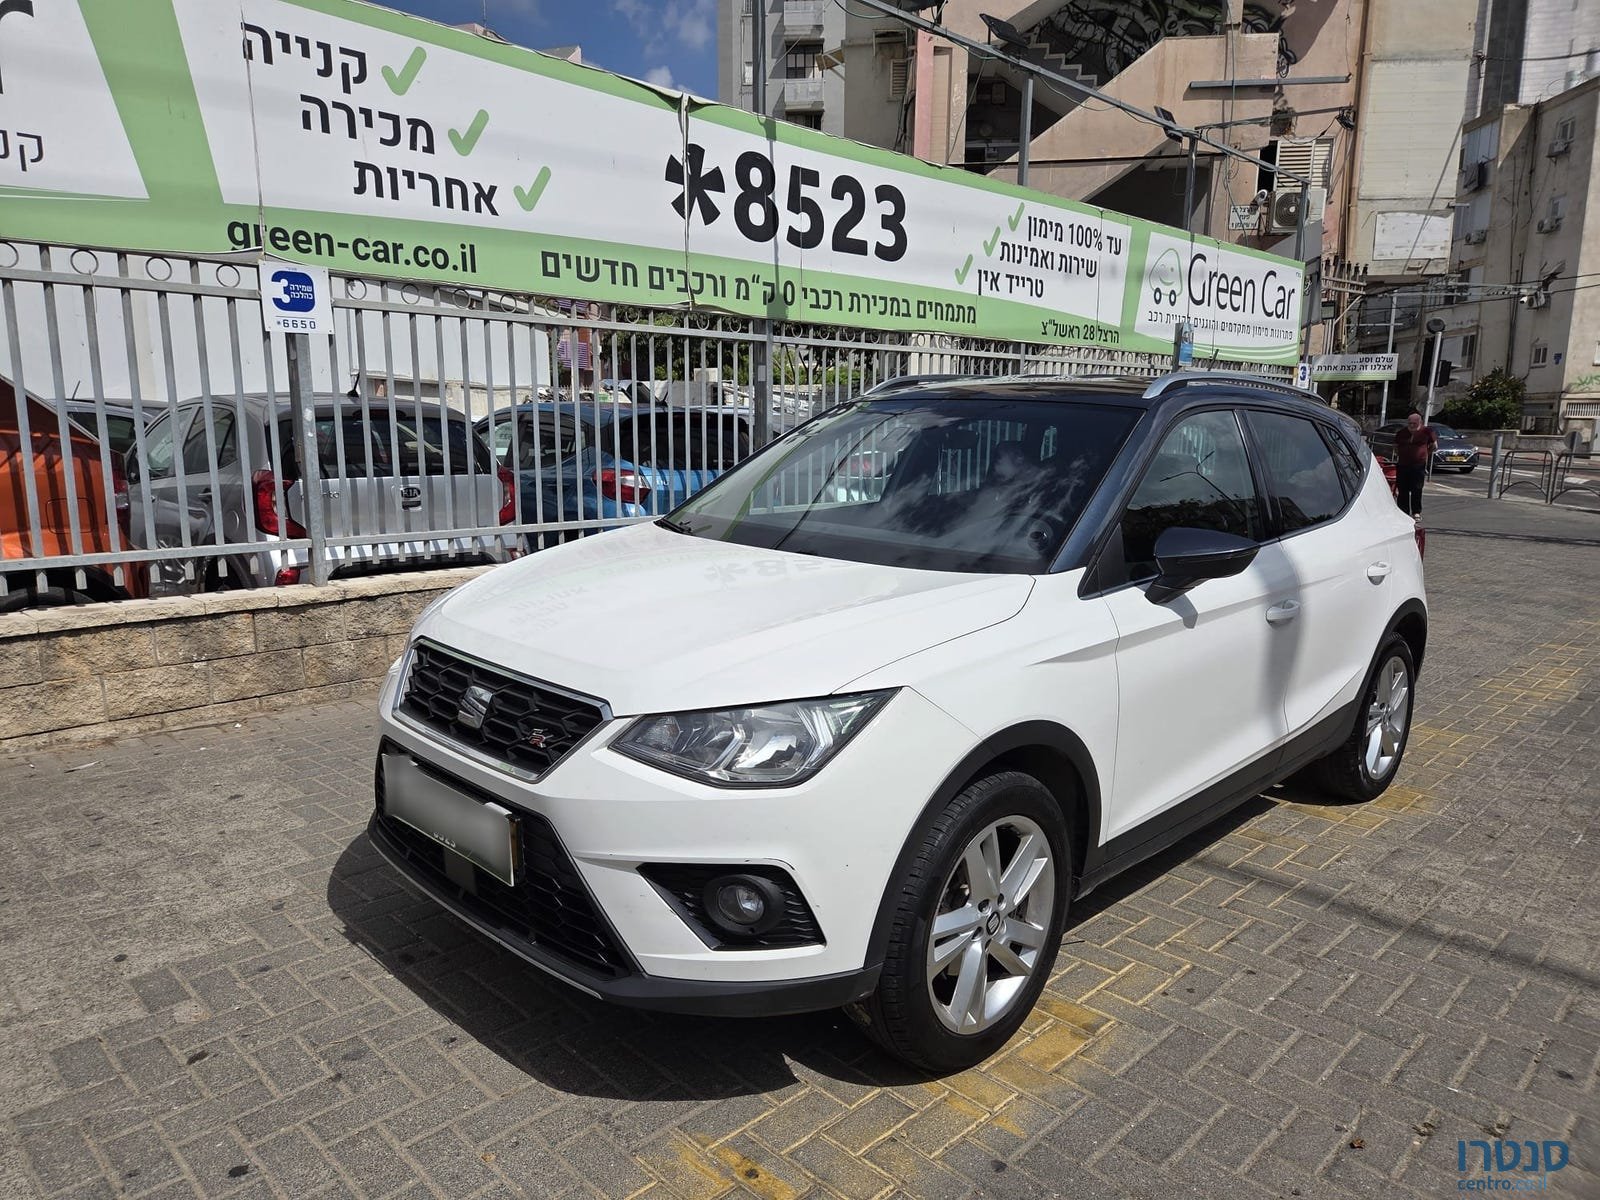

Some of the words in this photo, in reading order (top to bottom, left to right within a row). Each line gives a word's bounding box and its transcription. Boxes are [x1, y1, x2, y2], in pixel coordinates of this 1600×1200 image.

[240, 22, 368, 95] קנייה
[300, 94, 435, 155] מכירה
[353, 160, 500, 216] אחריות
[1027, 215, 1064, 242] מימון
[1068, 223, 1103, 251] 100%
[227, 220, 477, 274] green-car.co.il
[999, 241, 1055, 270] ואמינות
[1106, 235, 1122, 255] עד
[541, 250, 639, 287] חדשים
[1057, 253, 1097, 278] שירות
[289, 284, 313, 292] שמירה
[648, 265, 727, 298] ורכבים
[783, 280, 796, 306] 0
[977, 269, 1001, 296] אין
[1005, 273, 1044, 298] טרייד
[1187, 253, 1256, 314] Green
[1261, 270, 1296, 320] Car
[801, 286, 843, 311] רכבי
[848, 292, 912, 318] במכירת
[916, 300, 976, 324] מתמחים
[1147, 310, 1163, 323] רכב
[1082, 324, 1095, 341] 28
[1097, 325, 1120, 343] הרצל
[1220, 321, 1251, 336] מתקדמים
[1252, 325, 1269, 338] מימון
[1270, 327, 1293, 340] פתרונות
[1339, 364, 1357, 372] קצת
[1370, 363, 1393, 371] אצלנו
[1375, 356, 1394, 364] שלם
[402, 488, 420, 498] KIA
